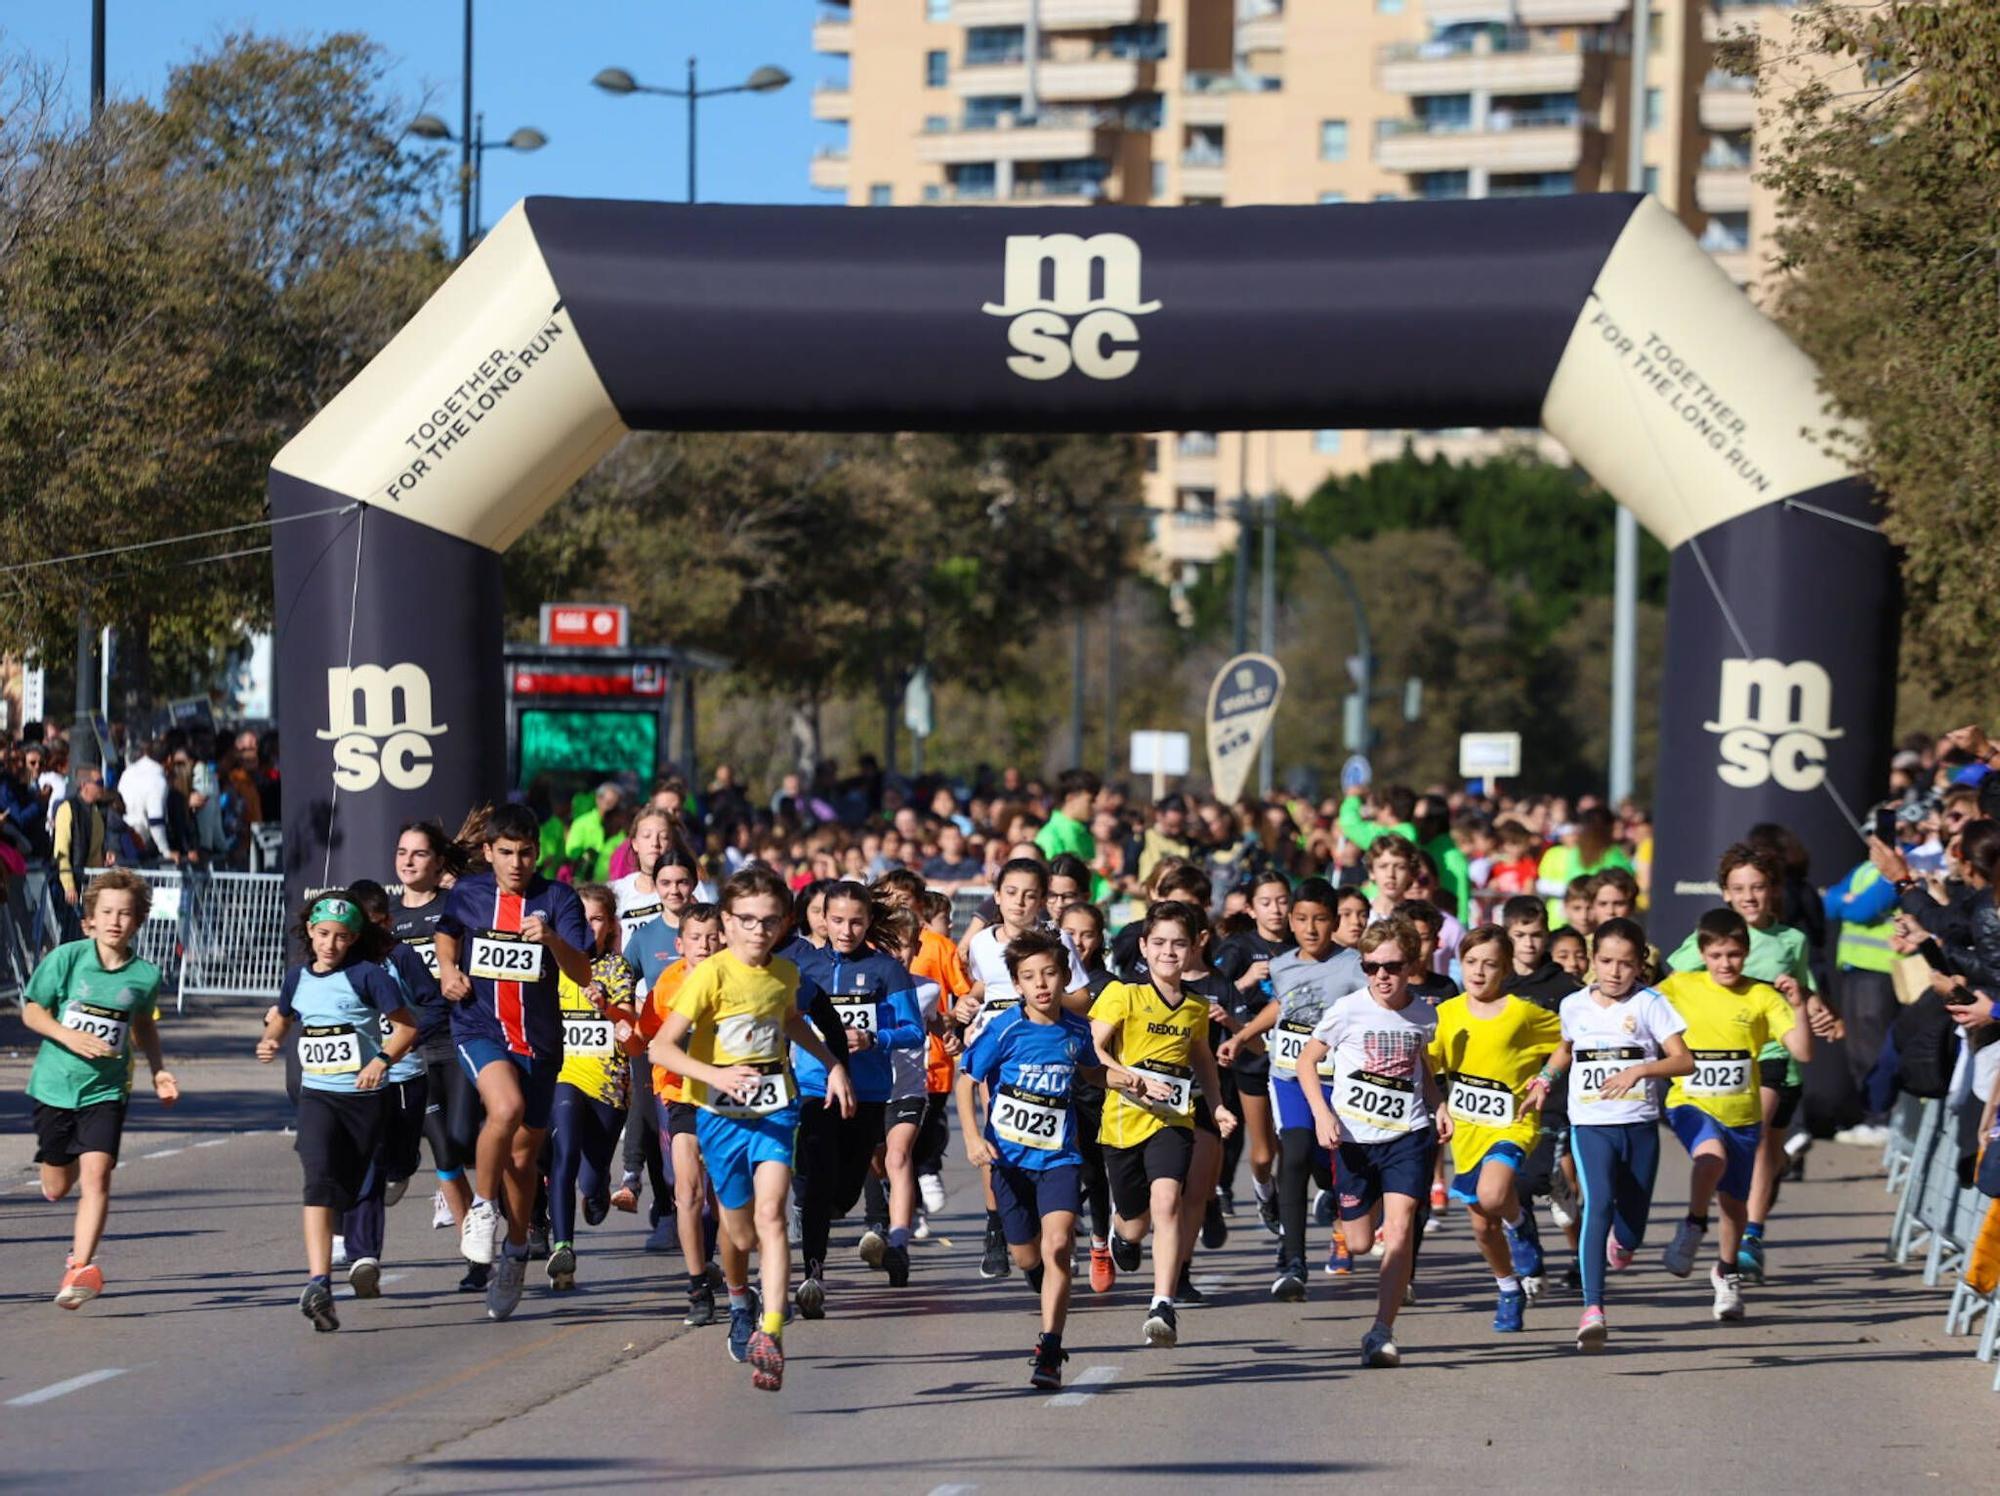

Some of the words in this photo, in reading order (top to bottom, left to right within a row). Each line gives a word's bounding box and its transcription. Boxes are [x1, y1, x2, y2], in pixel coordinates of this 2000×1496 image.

[981, 232, 1163, 381] msc
[387, 459, 431, 501] FOR
[426, 419, 471, 459] THE
[466, 365, 523, 422] LONG
[519, 321, 563, 368] RUN
[405, 349, 515, 450] TOGETHER,
[1590, 312, 1634, 356] FOR
[1633, 353, 1675, 396] THE
[1670, 393, 1727, 450] LONG
[1725, 448, 1770, 492] RUN
[1645, 332, 1747, 444] TOGETHER,
[316, 662, 448, 792] msc
[1703, 657, 1846, 792] msc
[478, 945, 533, 970] 2023
[304, 1042, 351, 1063] 2023
[843, 1010, 870, 1029] 23
[1347, 1086, 1405, 1119] 2023
[1455, 1088, 1505, 1117] 2023
[1691, 1066, 1744, 1087] 2023
[998, 1103, 1058, 1137] 2023
